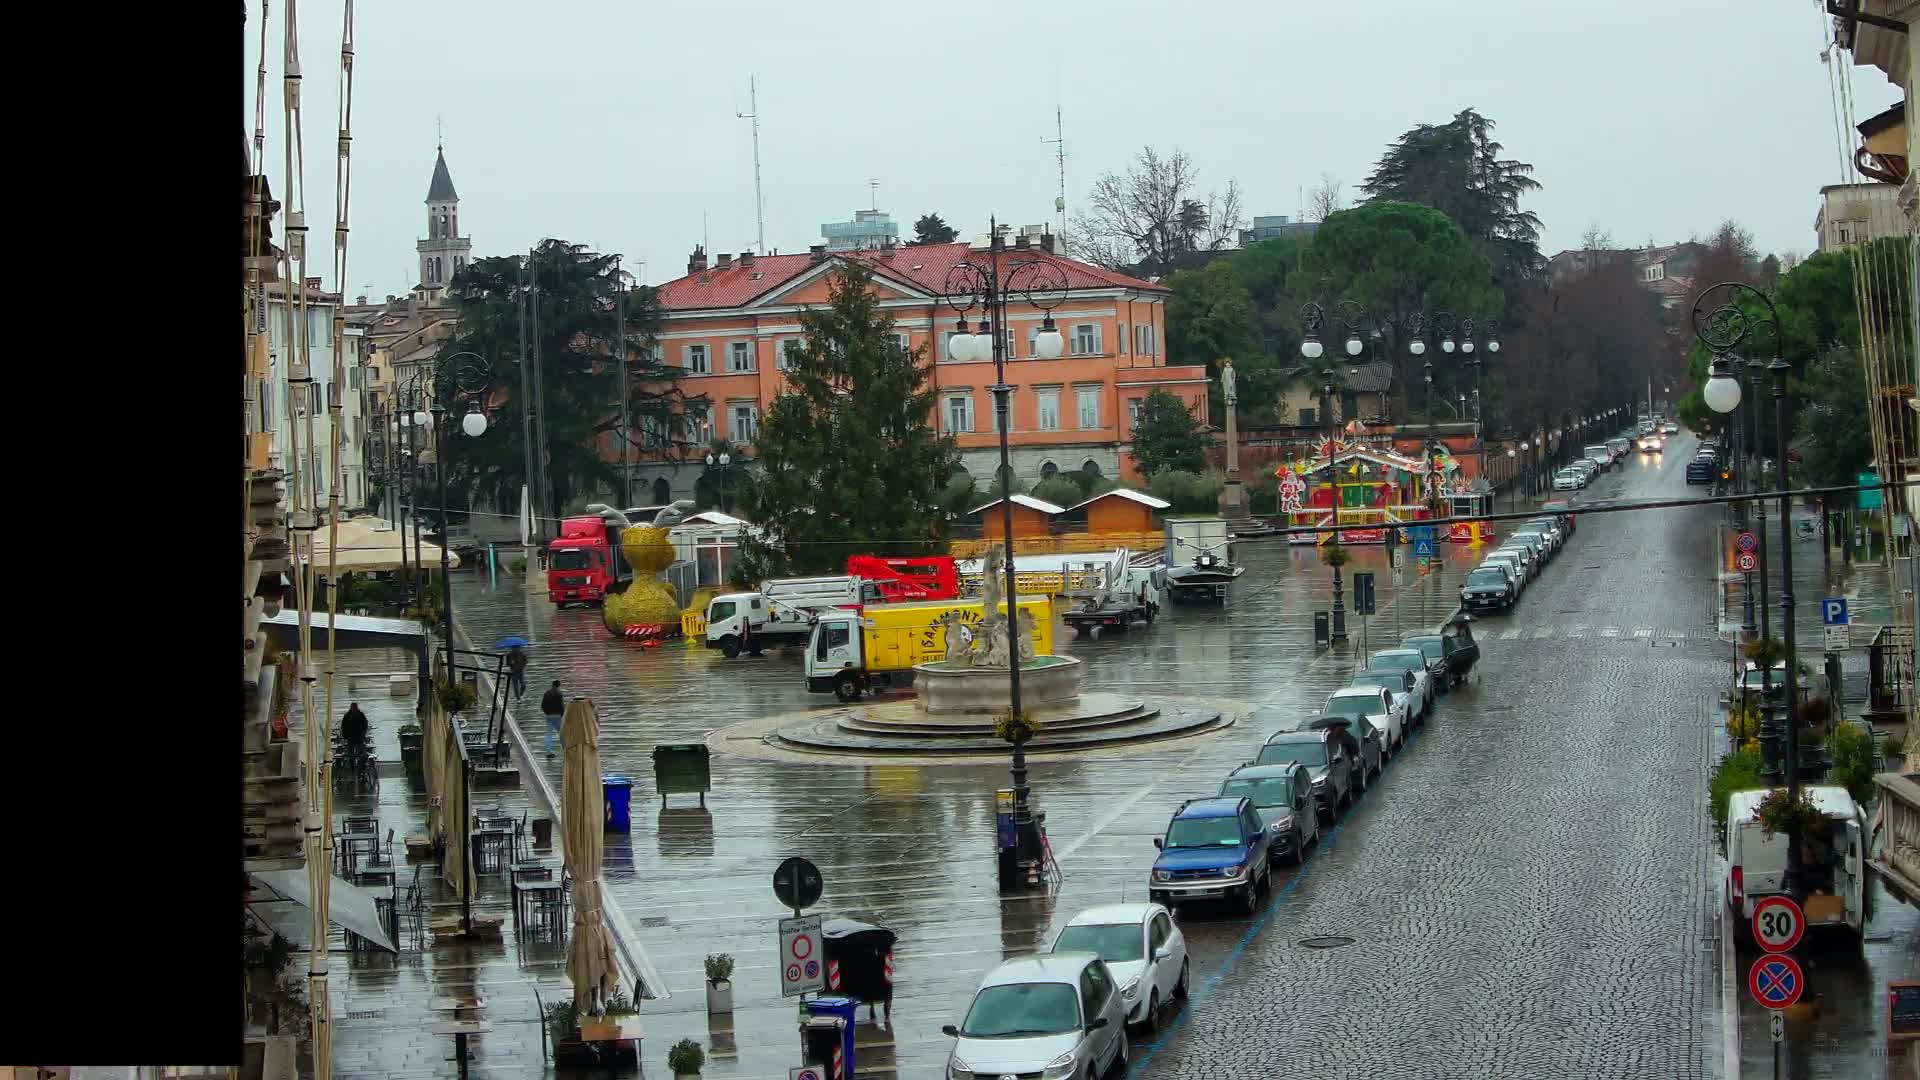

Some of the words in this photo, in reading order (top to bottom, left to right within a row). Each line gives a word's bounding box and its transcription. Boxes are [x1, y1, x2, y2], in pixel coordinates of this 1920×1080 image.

[1742, 557, 1752, 567] 20
[1828, 602, 1842, 621] P
[1762, 912, 1792, 937] 30
